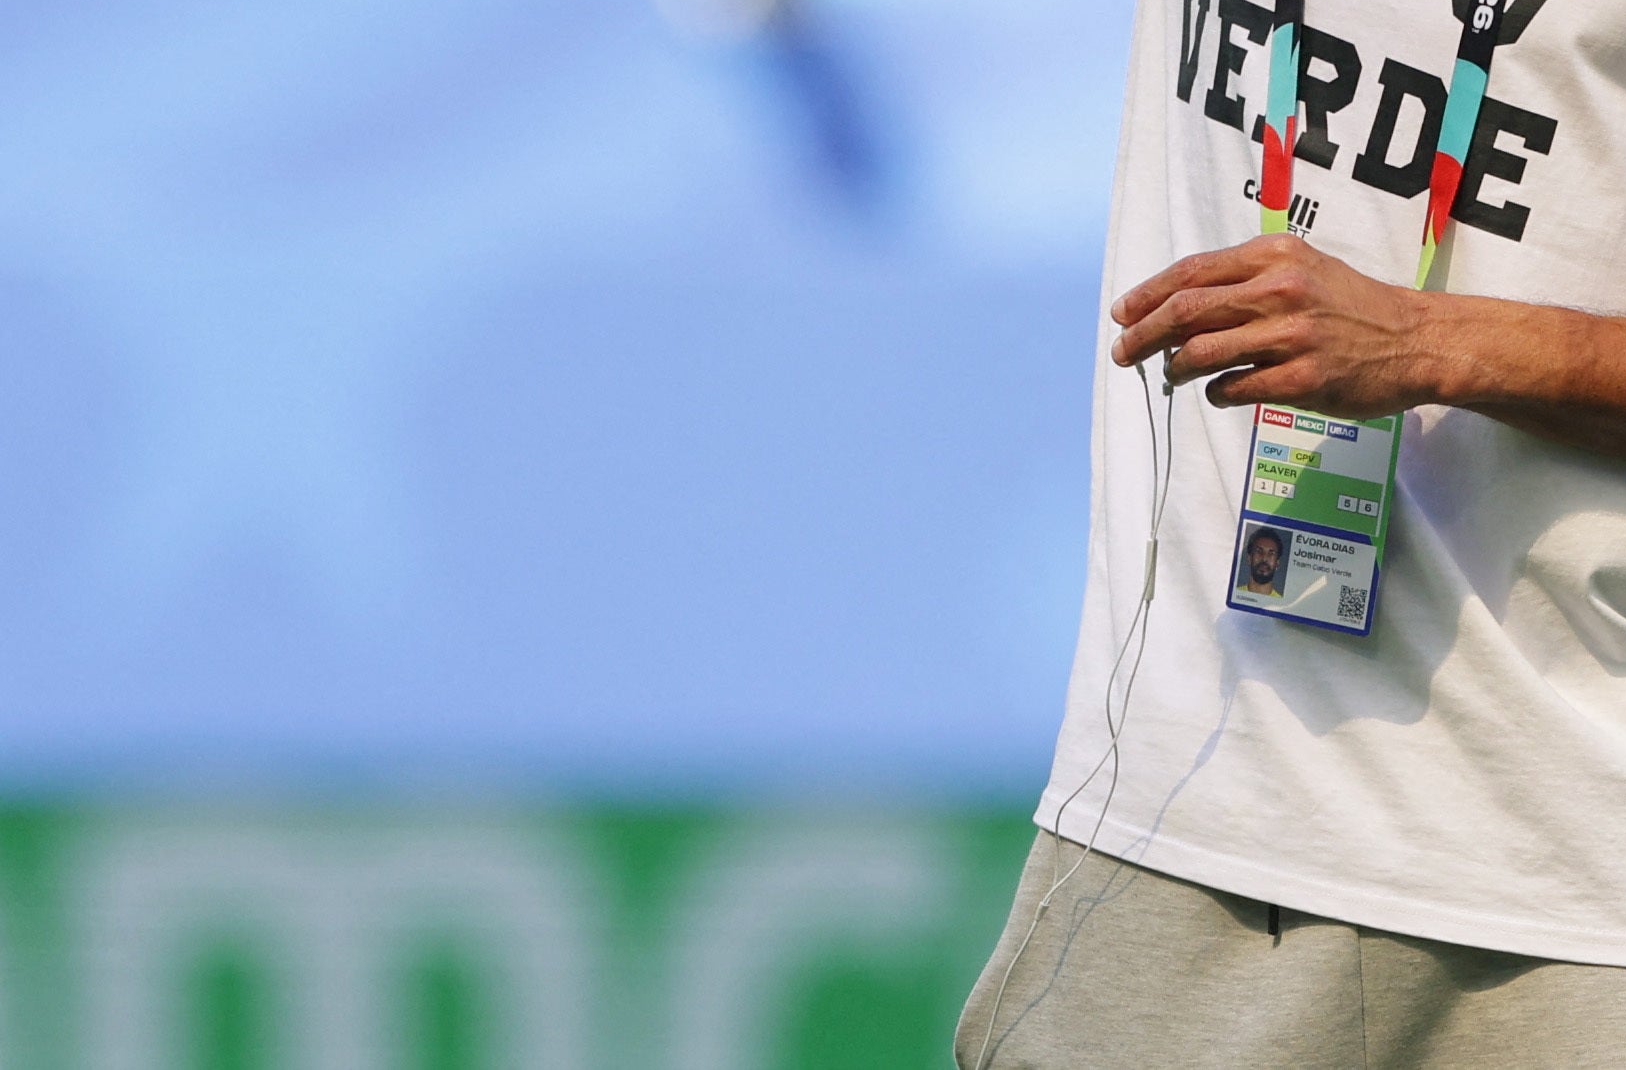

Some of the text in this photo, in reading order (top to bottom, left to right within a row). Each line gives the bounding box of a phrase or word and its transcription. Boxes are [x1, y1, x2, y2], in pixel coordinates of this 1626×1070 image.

[1296, 418, 1324, 431] MEXC
[1263, 445, 1283, 456] CPV
[1295, 452, 1316, 463] CPV
[1257, 462, 1298, 479] PLAYER
[1281, 486, 1288, 495] 2
[1344, 499, 1372, 513] 5 6
[1296, 534, 1355, 555] ÉVORA DIAS
[1294, 549, 1337, 564] Josimar
